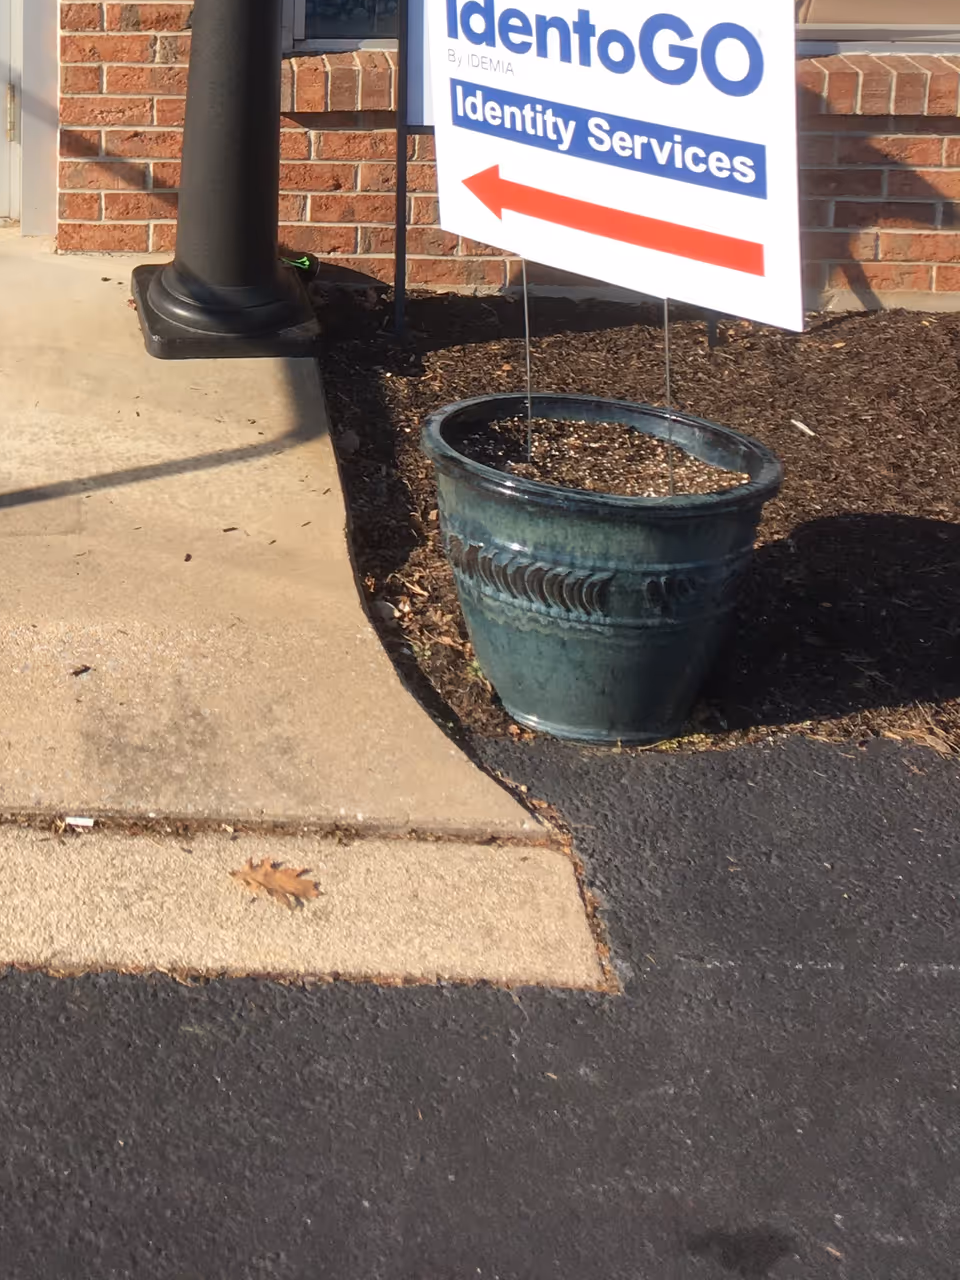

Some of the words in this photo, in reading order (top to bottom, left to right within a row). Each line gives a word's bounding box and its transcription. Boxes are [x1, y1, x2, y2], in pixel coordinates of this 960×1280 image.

[448, 48, 462, 71] By
[468, 53, 515, 77] IDEMIA
[455, 84, 576, 151] Identity
[587, 116, 757, 185] Services
